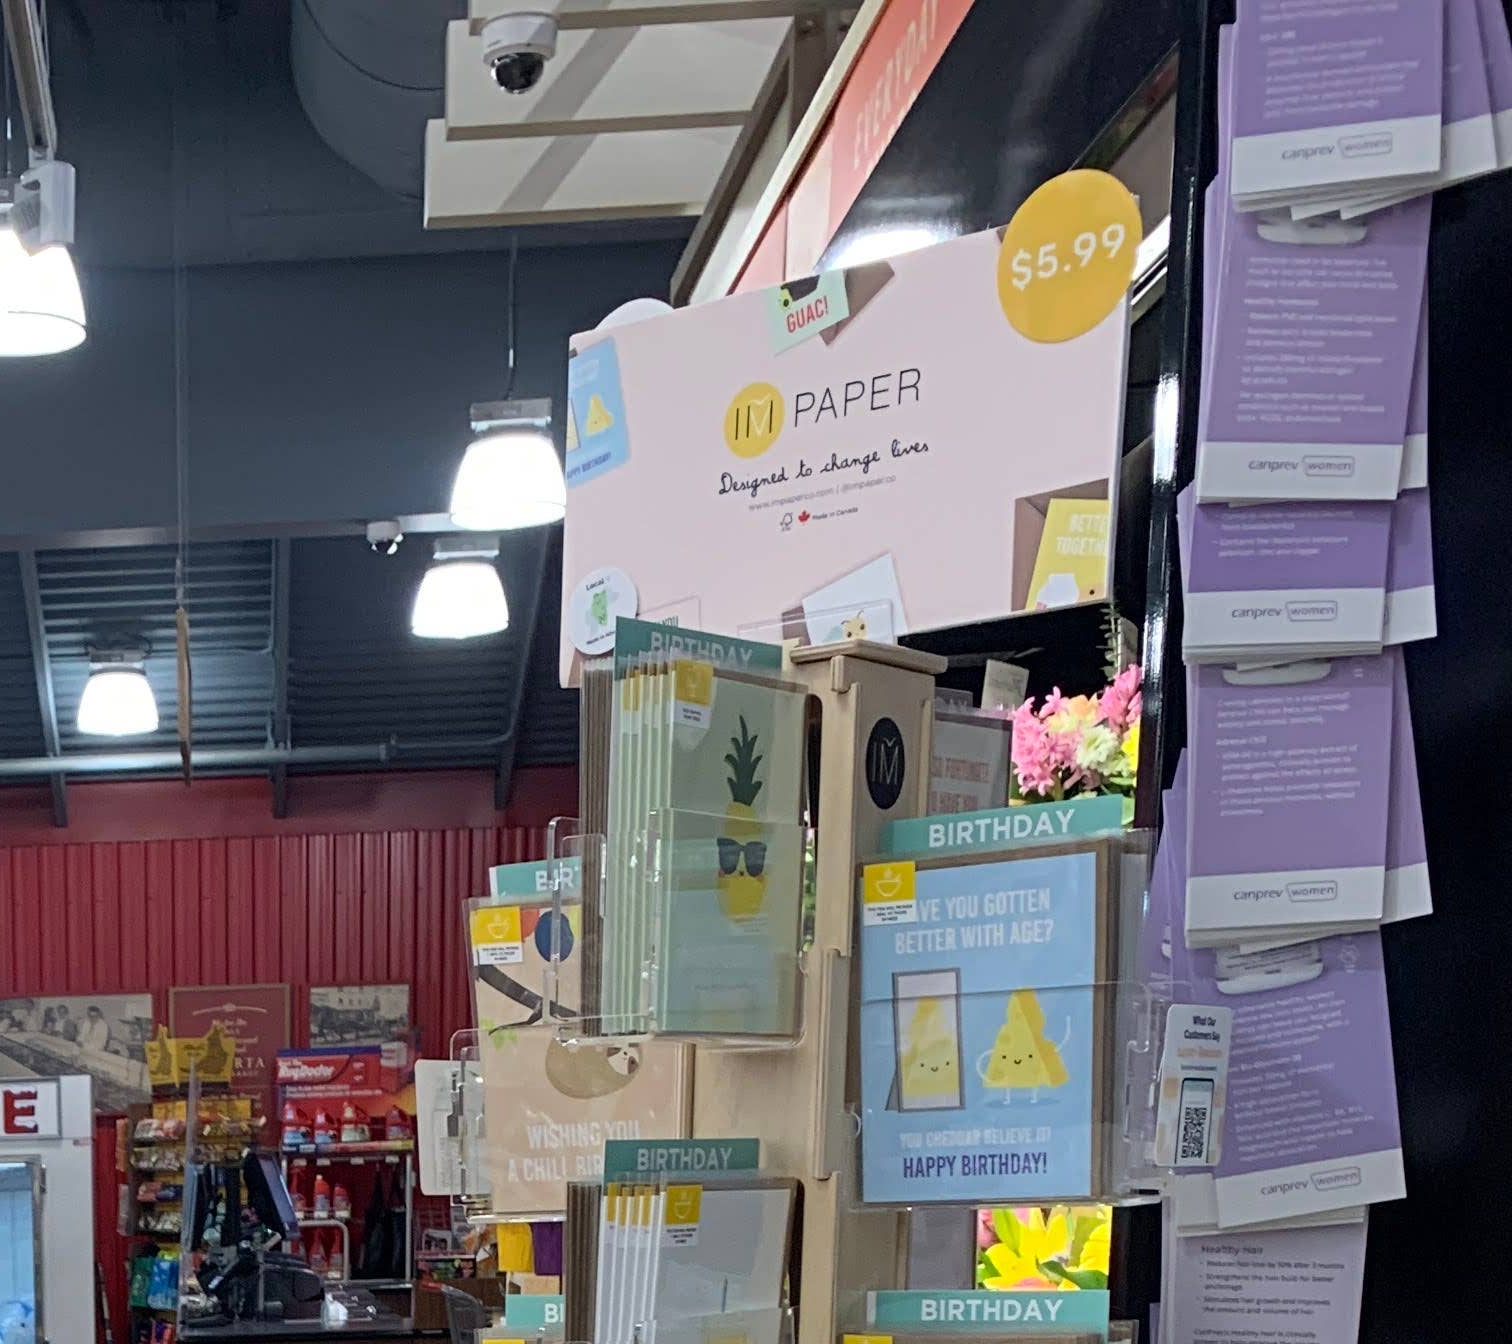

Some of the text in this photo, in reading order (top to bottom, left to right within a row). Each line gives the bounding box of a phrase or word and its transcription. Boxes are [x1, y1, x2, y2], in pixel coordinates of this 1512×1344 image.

[1010, 223, 1126, 290] $5.99
[785, 294, 829, 334] GUAC!
[794, 368, 921, 427] PAPER
[718, 439, 929, 498] Designed to change lives
[1248, 459, 1352, 472] canprev women
[1231, 605, 1334, 620] canprev women
[651, 631, 753, 669] BIRTHDAY
[929, 808, 1075, 848] BIRTHDAY
[912, 888, 1050, 922] AVE YOU GOTTEN
[1234, 886, 1334, 902] canprev women
[895, 919, 1054, 955] BETTER WITH AGE?
[527, 1119, 639, 1150] WISHING YOU
[507, 1156, 567, 1181] A CHILL
[638, 1147, 733, 1171] BIRTHDAY
[903, 1152, 1048, 1178] HAPPY BIRTHDAY!
[1260, 1179, 1309, 1196] canprev
[920, 1298, 1064, 1322] BIRTHDAY
